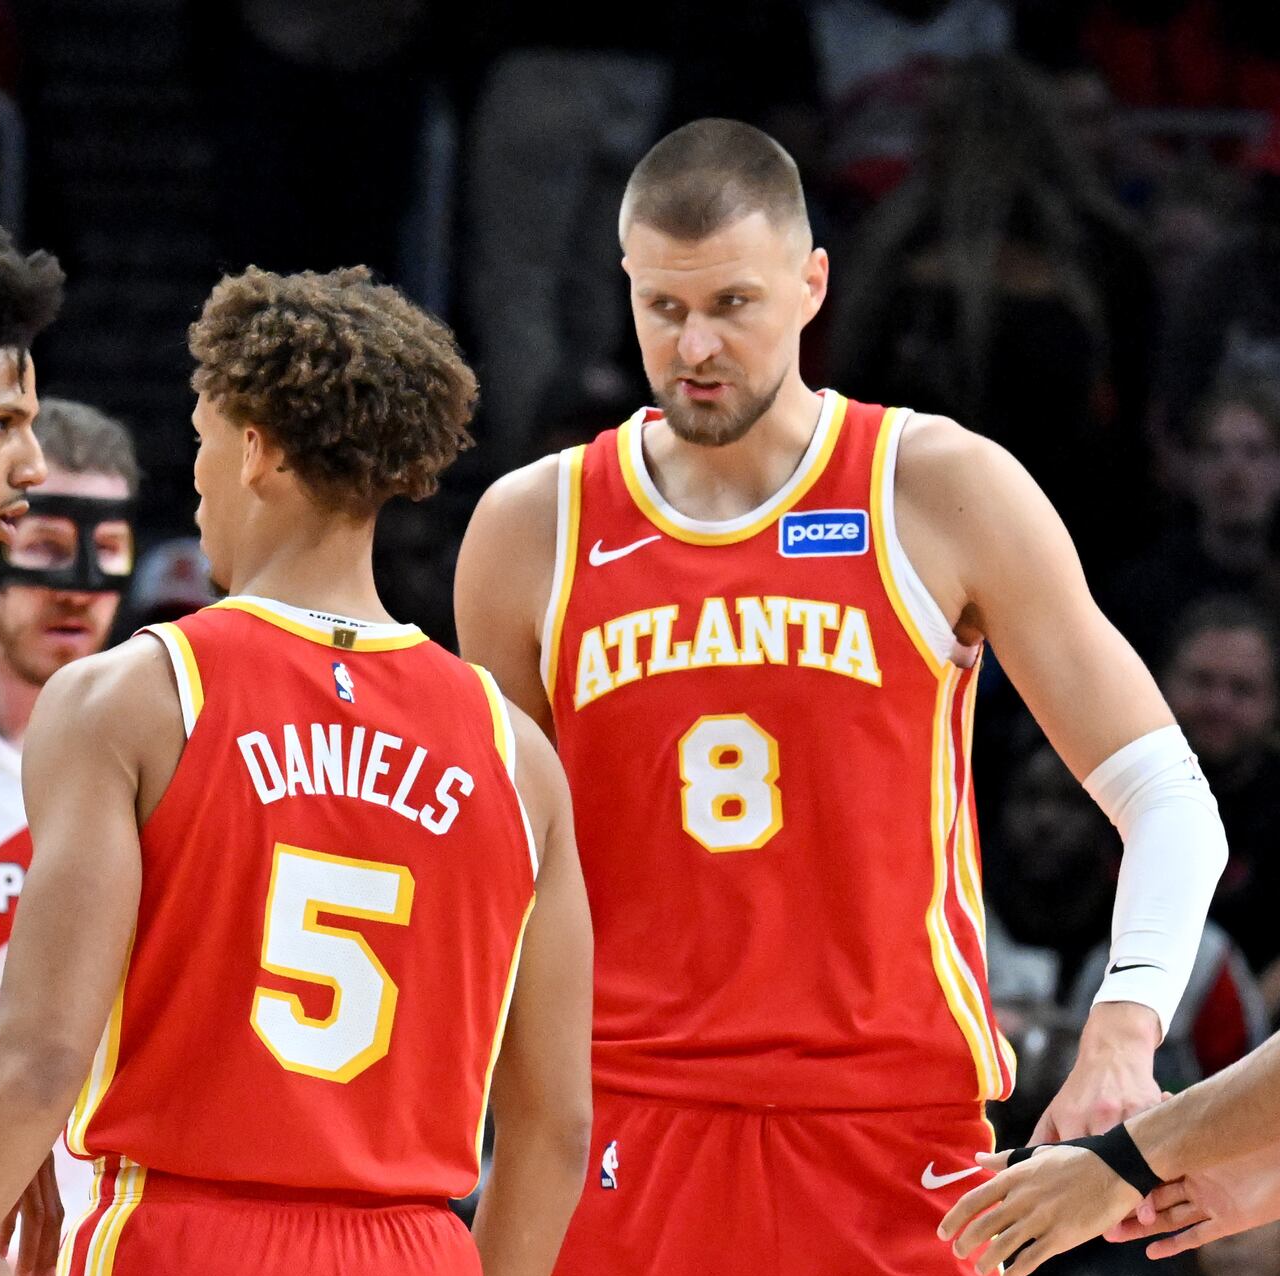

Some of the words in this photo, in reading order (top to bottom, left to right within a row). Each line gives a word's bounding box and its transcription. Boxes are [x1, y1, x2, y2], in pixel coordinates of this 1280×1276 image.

[788, 522, 861, 547] paze
[573, 596, 883, 712] ATLANTA
[237, 723, 475, 836] DANIELS
[678, 712, 784, 854] 8
[250, 842, 417, 1085] 5
